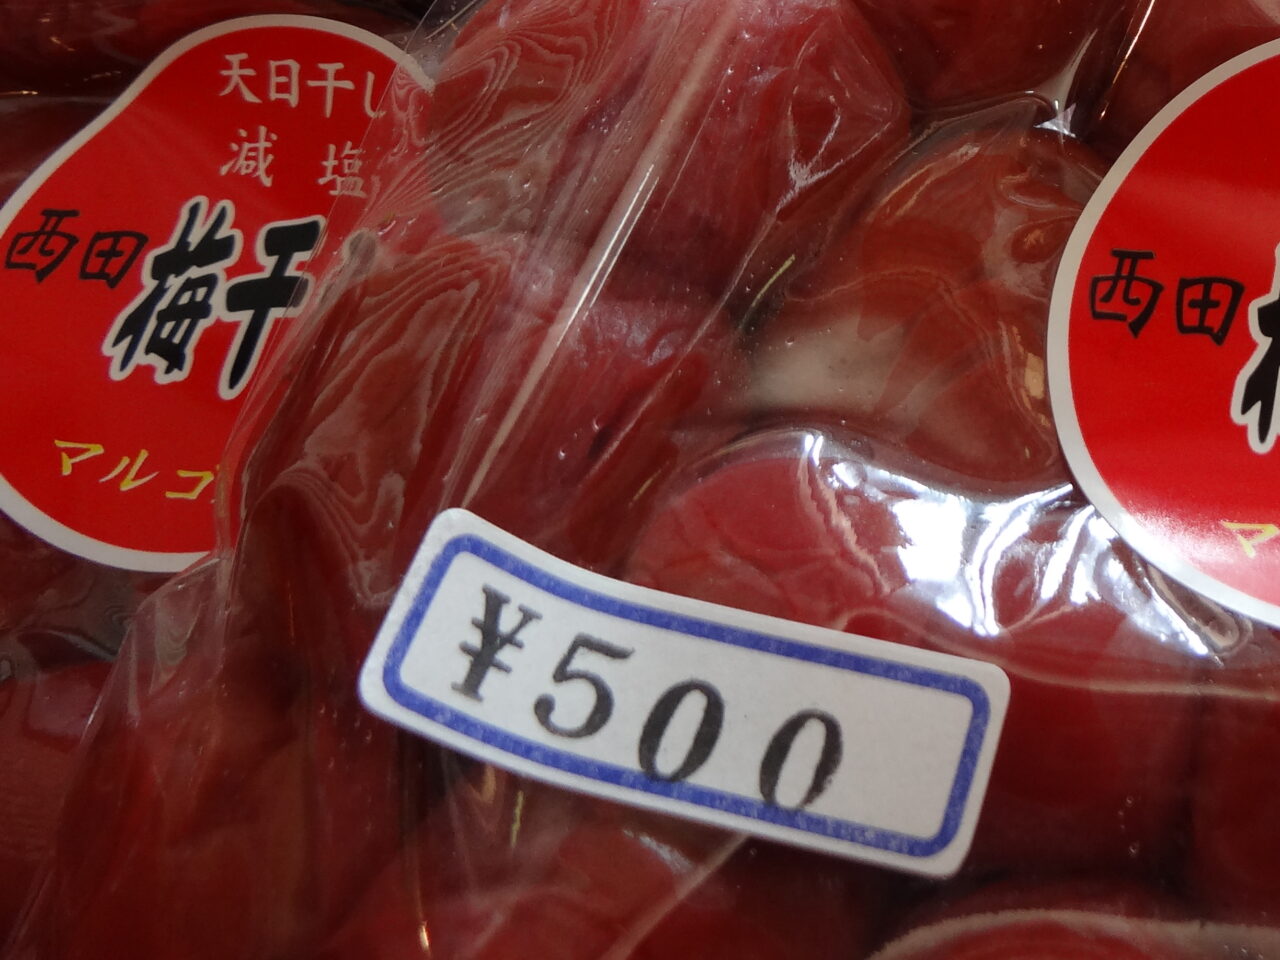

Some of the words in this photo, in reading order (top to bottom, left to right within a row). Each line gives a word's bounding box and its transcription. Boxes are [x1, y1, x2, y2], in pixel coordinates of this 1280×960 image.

[219, 52, 387, 119] 天日干し
[4, 208, 150, 289] 西田
[1090, 248, 1246, 346] 西田
[451, 583, 843, 813] ¥500
